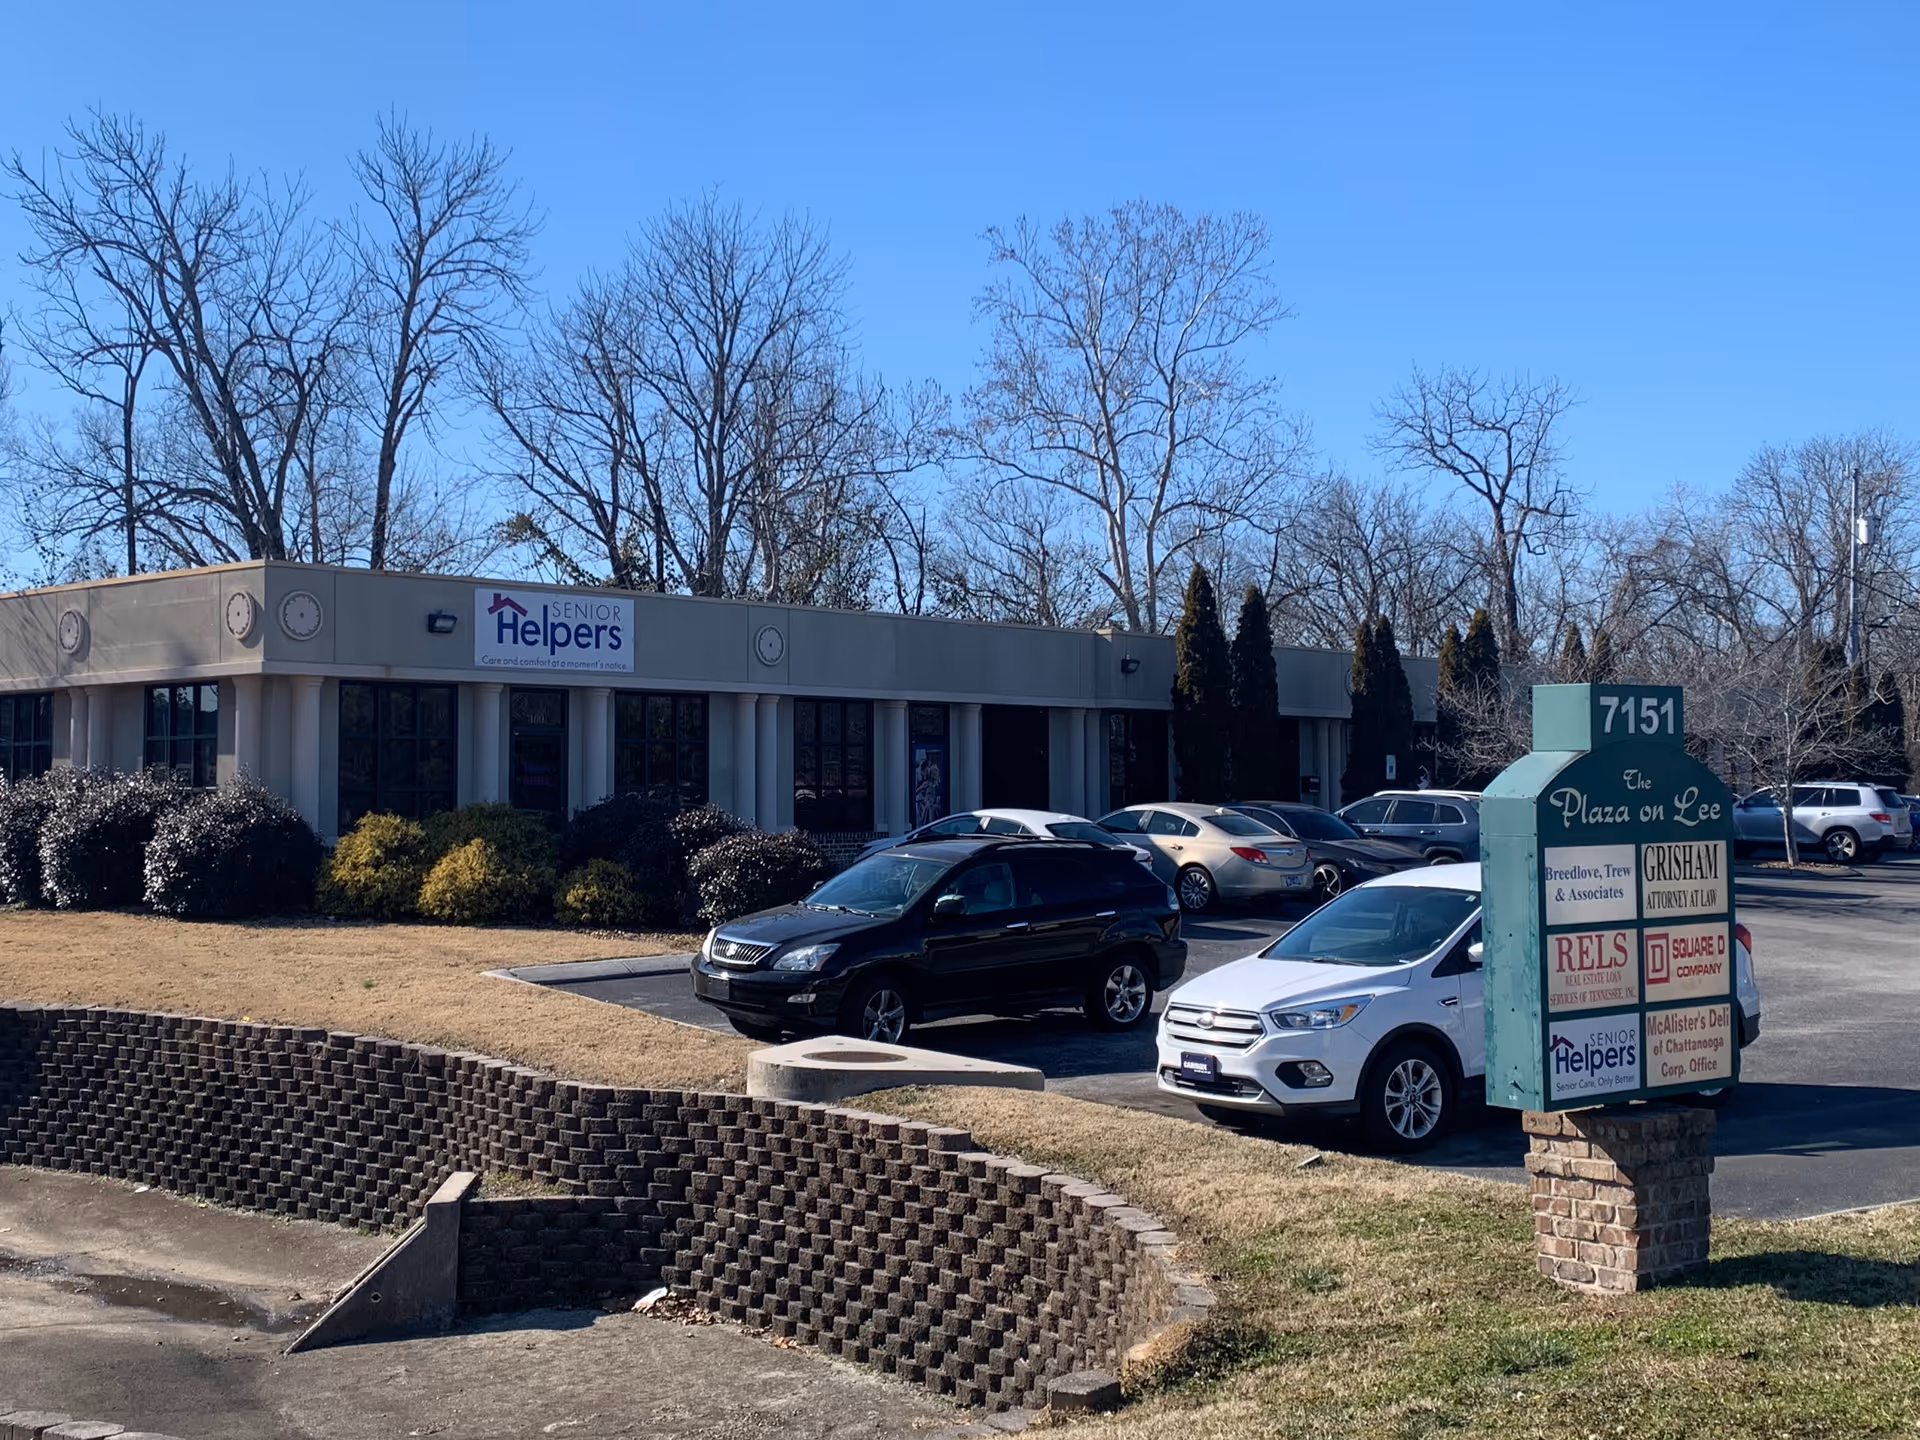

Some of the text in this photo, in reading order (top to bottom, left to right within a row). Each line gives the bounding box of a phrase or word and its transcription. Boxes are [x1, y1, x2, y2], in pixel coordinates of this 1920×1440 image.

[552, 601, 621, 621] SENIOR
[497, 604, 622, 656] Helpers
[481, 654, 501, 665] Care
[502, 656, 518, 665] and
[519, 656, 551, 667] comfort
[551, 659, 560, 668] at
[560, 660, 566, 668] a
[566, 659, 604, 669] moment's
[1600, 696, 1674, 735] 7151
[1623, 769, 1652, 790] The
[1549, 786, 1721, 829] Plaza on Lee
[1545, 864, 1632, 881] Breedlove, Trew
[1643, 843, 1719, 882] GRISHAM
[1555, 886, 1624, 902] & Associates
[1646, 888, 1718, 909] ATTORNEY AT LAW
[1555, 932, 1629, 973] RELS
[1672, 935, 1725, 959] SQUARE D
[1651, 944, 1665, 973] D
[1565, 970, 1622, 987] REAL ESTATE LOAN
[1676, 963, 1722, 978] COMPANY
[1550, 992, 1578, 1007] SERVICES
[1579, 991, 1588, 1002] OF
[1647, 1007, 1729, 1036] McAlister's Deli
[1590, 1029, 1636, 1047] SENIOR
[1653, 1036, 1724, 1056] of Chattanooga
[1555, 1043, 1636, 1077] Helpers
[1661, 1057, 1718, 1078] Corp. Office
[1556, 1081, 1577, 1092] Senior
[1578, 1079, 1596, 1089] Care,
[1597, 1076, 1613, 1088] Only
